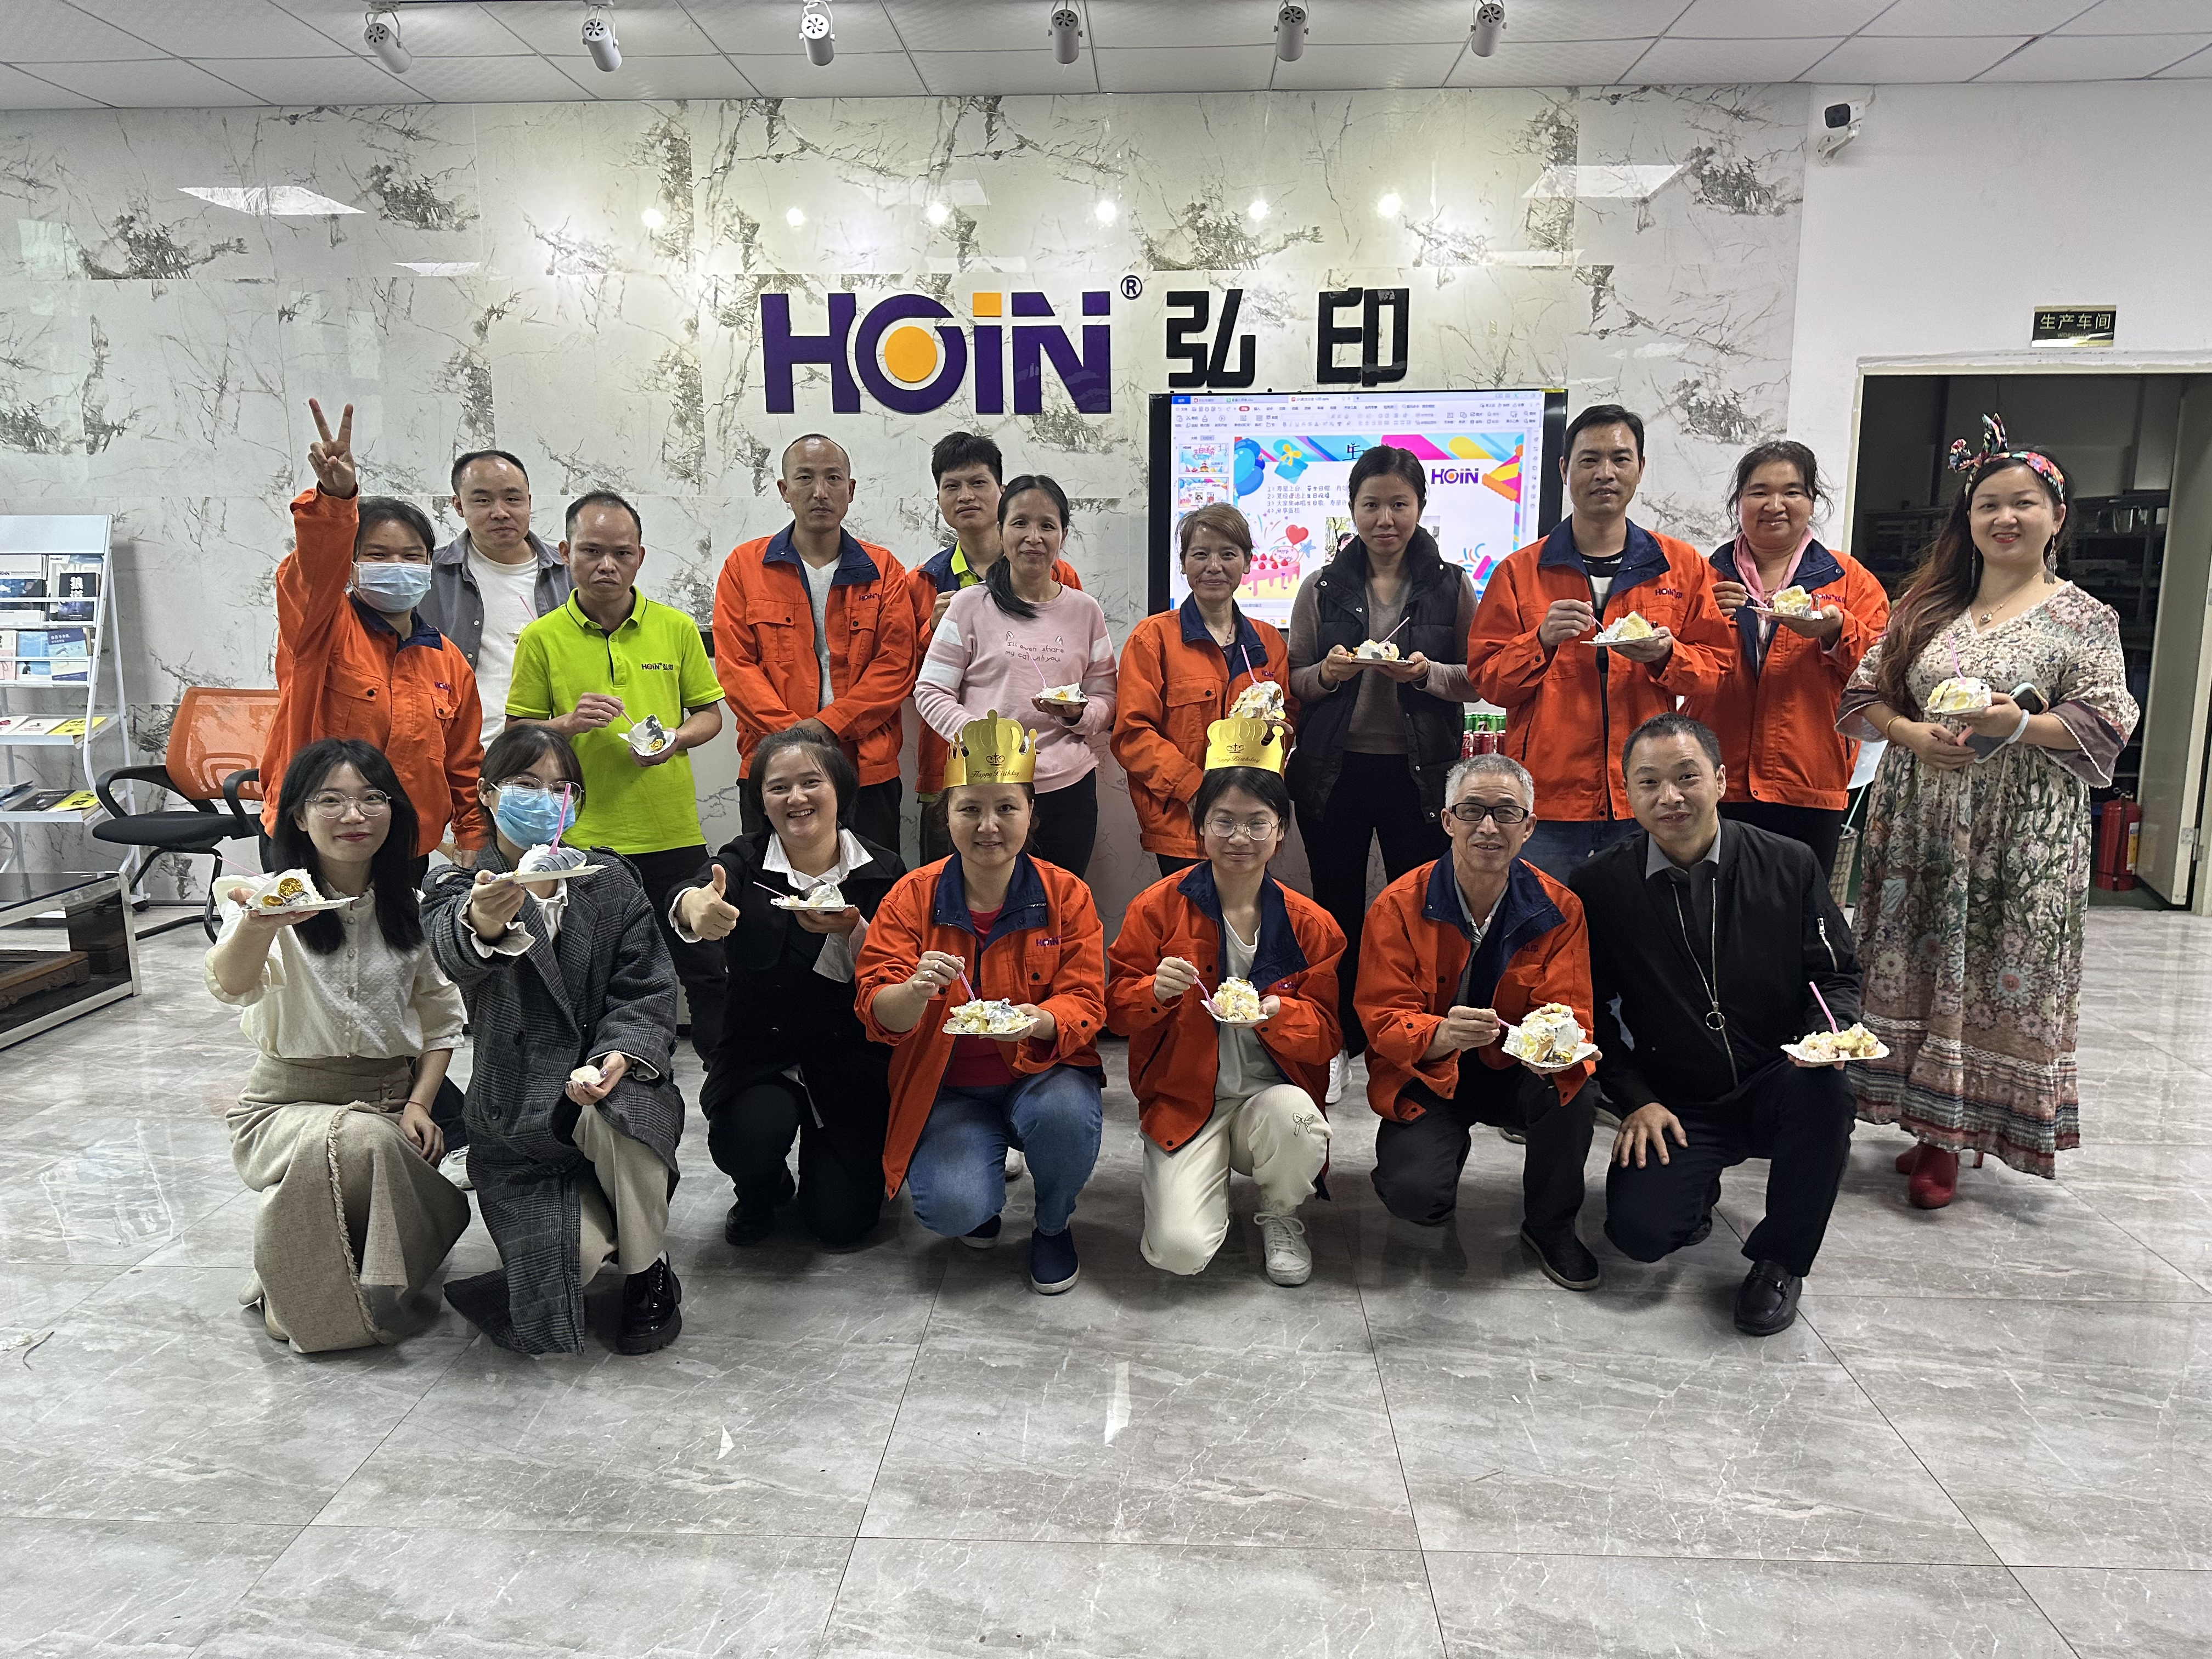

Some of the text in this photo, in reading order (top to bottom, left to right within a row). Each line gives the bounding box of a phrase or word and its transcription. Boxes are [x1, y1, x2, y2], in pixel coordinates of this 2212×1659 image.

[2040, 313, 2111, 330] 生产车间
[1042, 645, 1064, 653] share
[1231, 755, 1260, 764] Birthday
[970, 770, 993, 779] Happy
